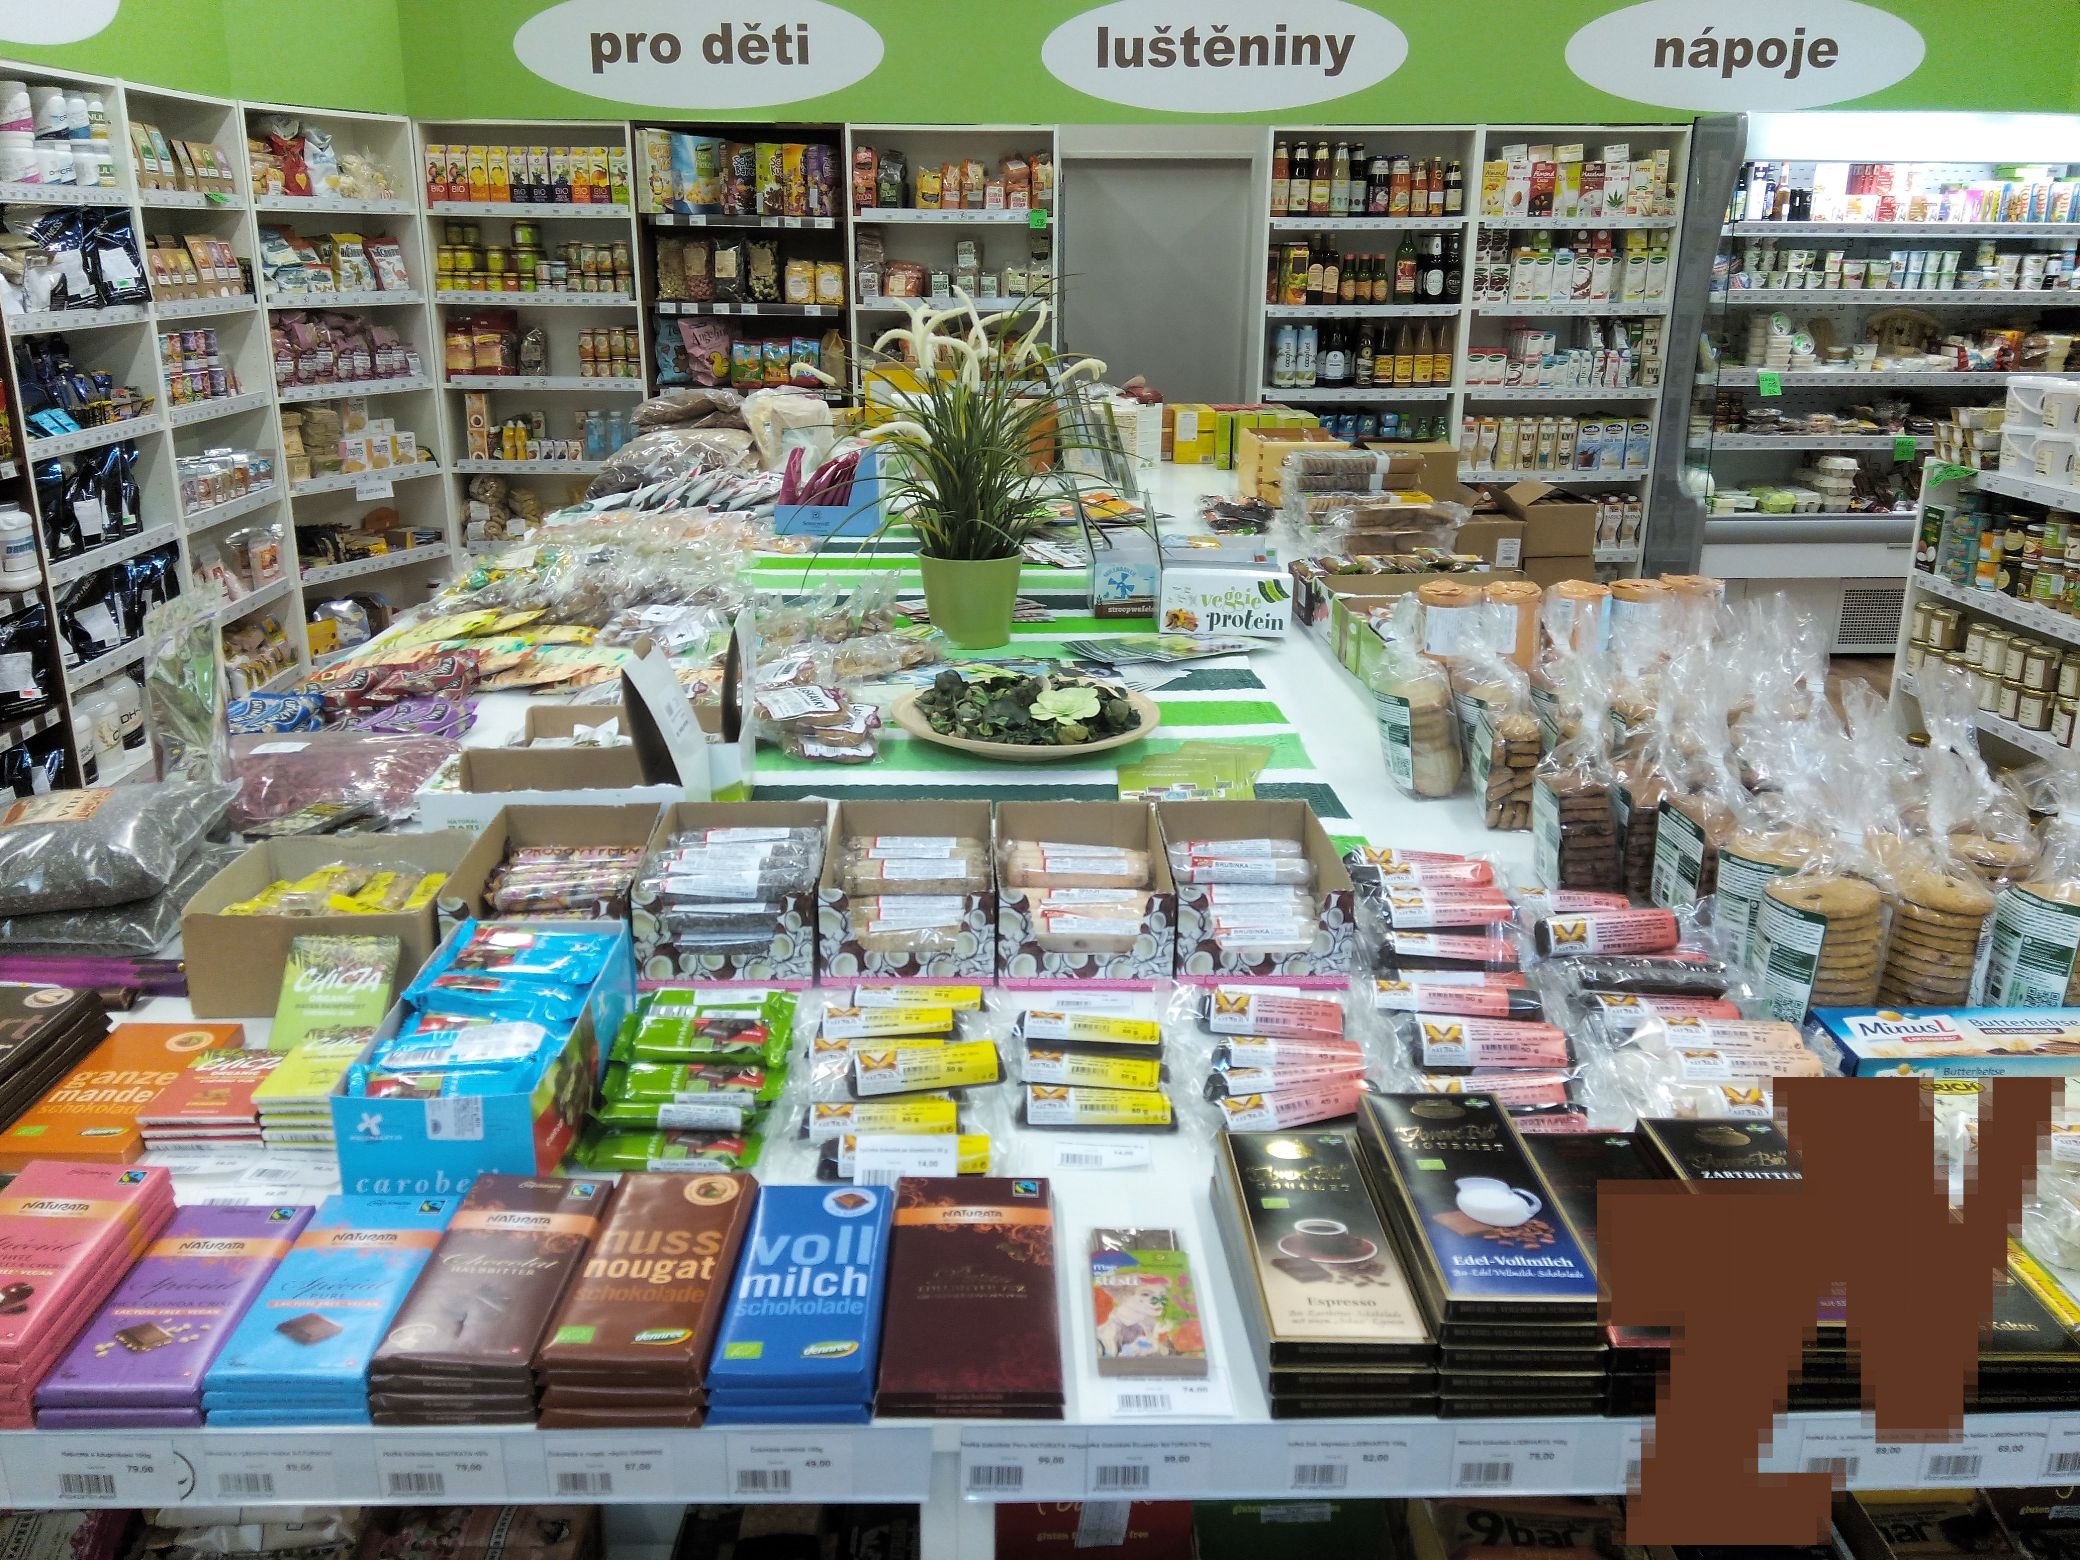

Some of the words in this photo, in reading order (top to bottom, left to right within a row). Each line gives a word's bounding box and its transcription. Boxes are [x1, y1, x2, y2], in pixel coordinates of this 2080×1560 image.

[590, 26, 682, 74] pro
[702, 22, 809, 66] děti
[1096, 25, 1356, 77] luštěniny
[1653, 26, 1839, 80] nápoje
[430, 185, 445, 193] BIO
[451, 185, 466, 193] BIO
[1202, 585, 1262, 614] veggie
[1206, 609, 1284, 632] protein
[1215, 861, 1249, 869] BRUSINKA
[1968, 1018, 2079, 1028] Butterkekse
[1943, 1066, 2006, 1077] Butterkekse
[64, 1071, 179, 1090] ganze
[48, 1086, 165, 1103] mandel
[21, 1201, 90, 1212] NATURATA
[942, 1209, 1003, 1219] NATURATA
[486, 1215, 552, 1225] NATURATA
[178, 1241, 245, 1251] NATURATA
[332, 1233, 399, 1242] NATURATA
[602, 1230, 723, 1256] nuss
[757, 1225, 874, 1266] voll
[583, 1256, 717, 1284] nougat
[1452, 1255, 1575, 1268] Edel-Vollmilch
[739, 1266, 868, 1299] milch
[575, 1285, 704, 1303] schokolade
[734, 1298, 863, 1317] schokolade
